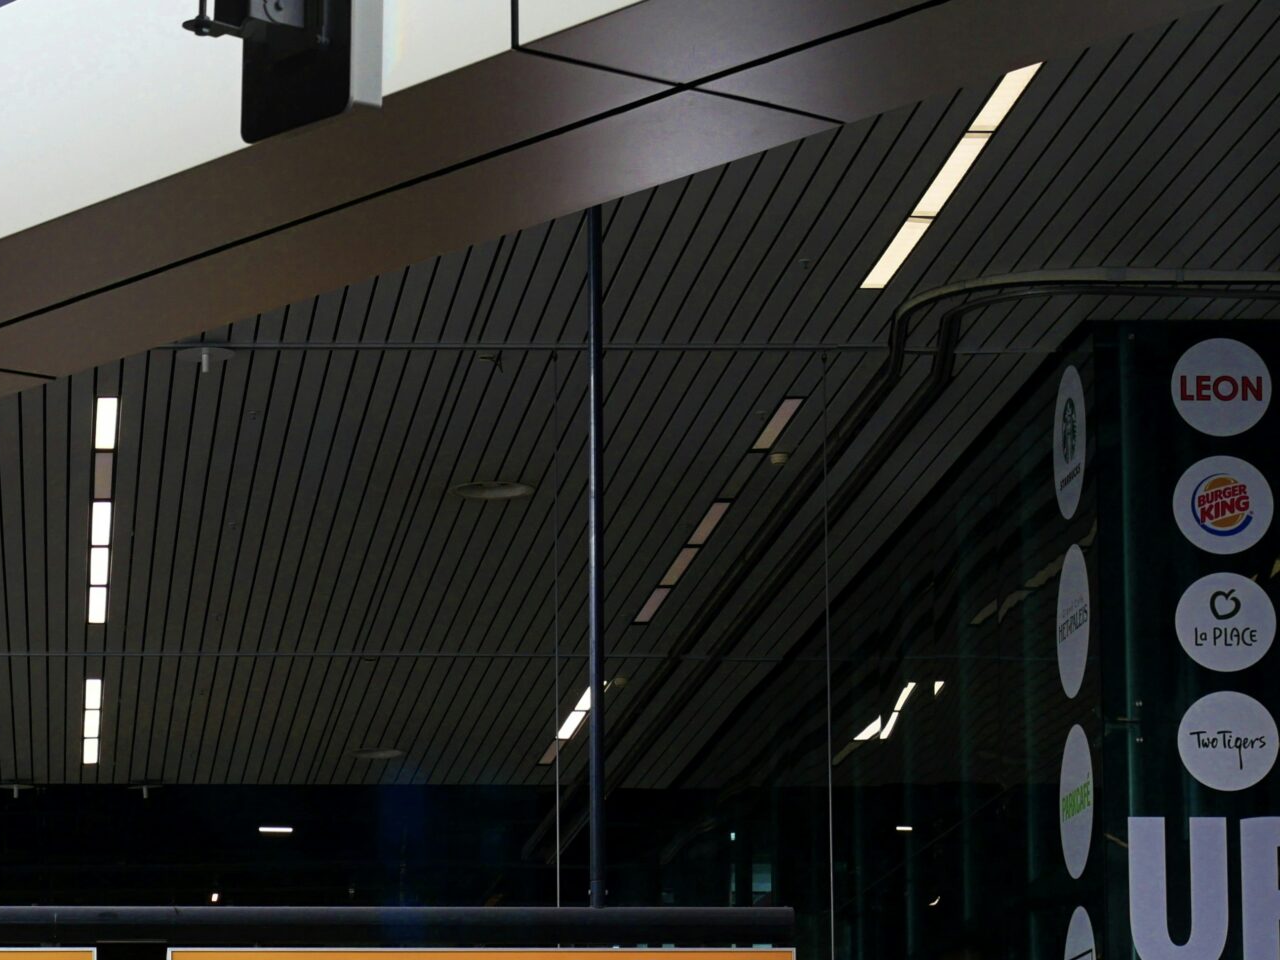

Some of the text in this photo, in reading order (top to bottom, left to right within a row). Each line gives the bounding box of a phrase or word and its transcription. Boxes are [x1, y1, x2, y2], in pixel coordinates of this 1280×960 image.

[1180, 375, 1263, 401] LEON
[1197, 484, 1247, 507] BURGER
[1200, 495, 1249, 523] KING
[1213, 627, 1258, 646] PLACE
